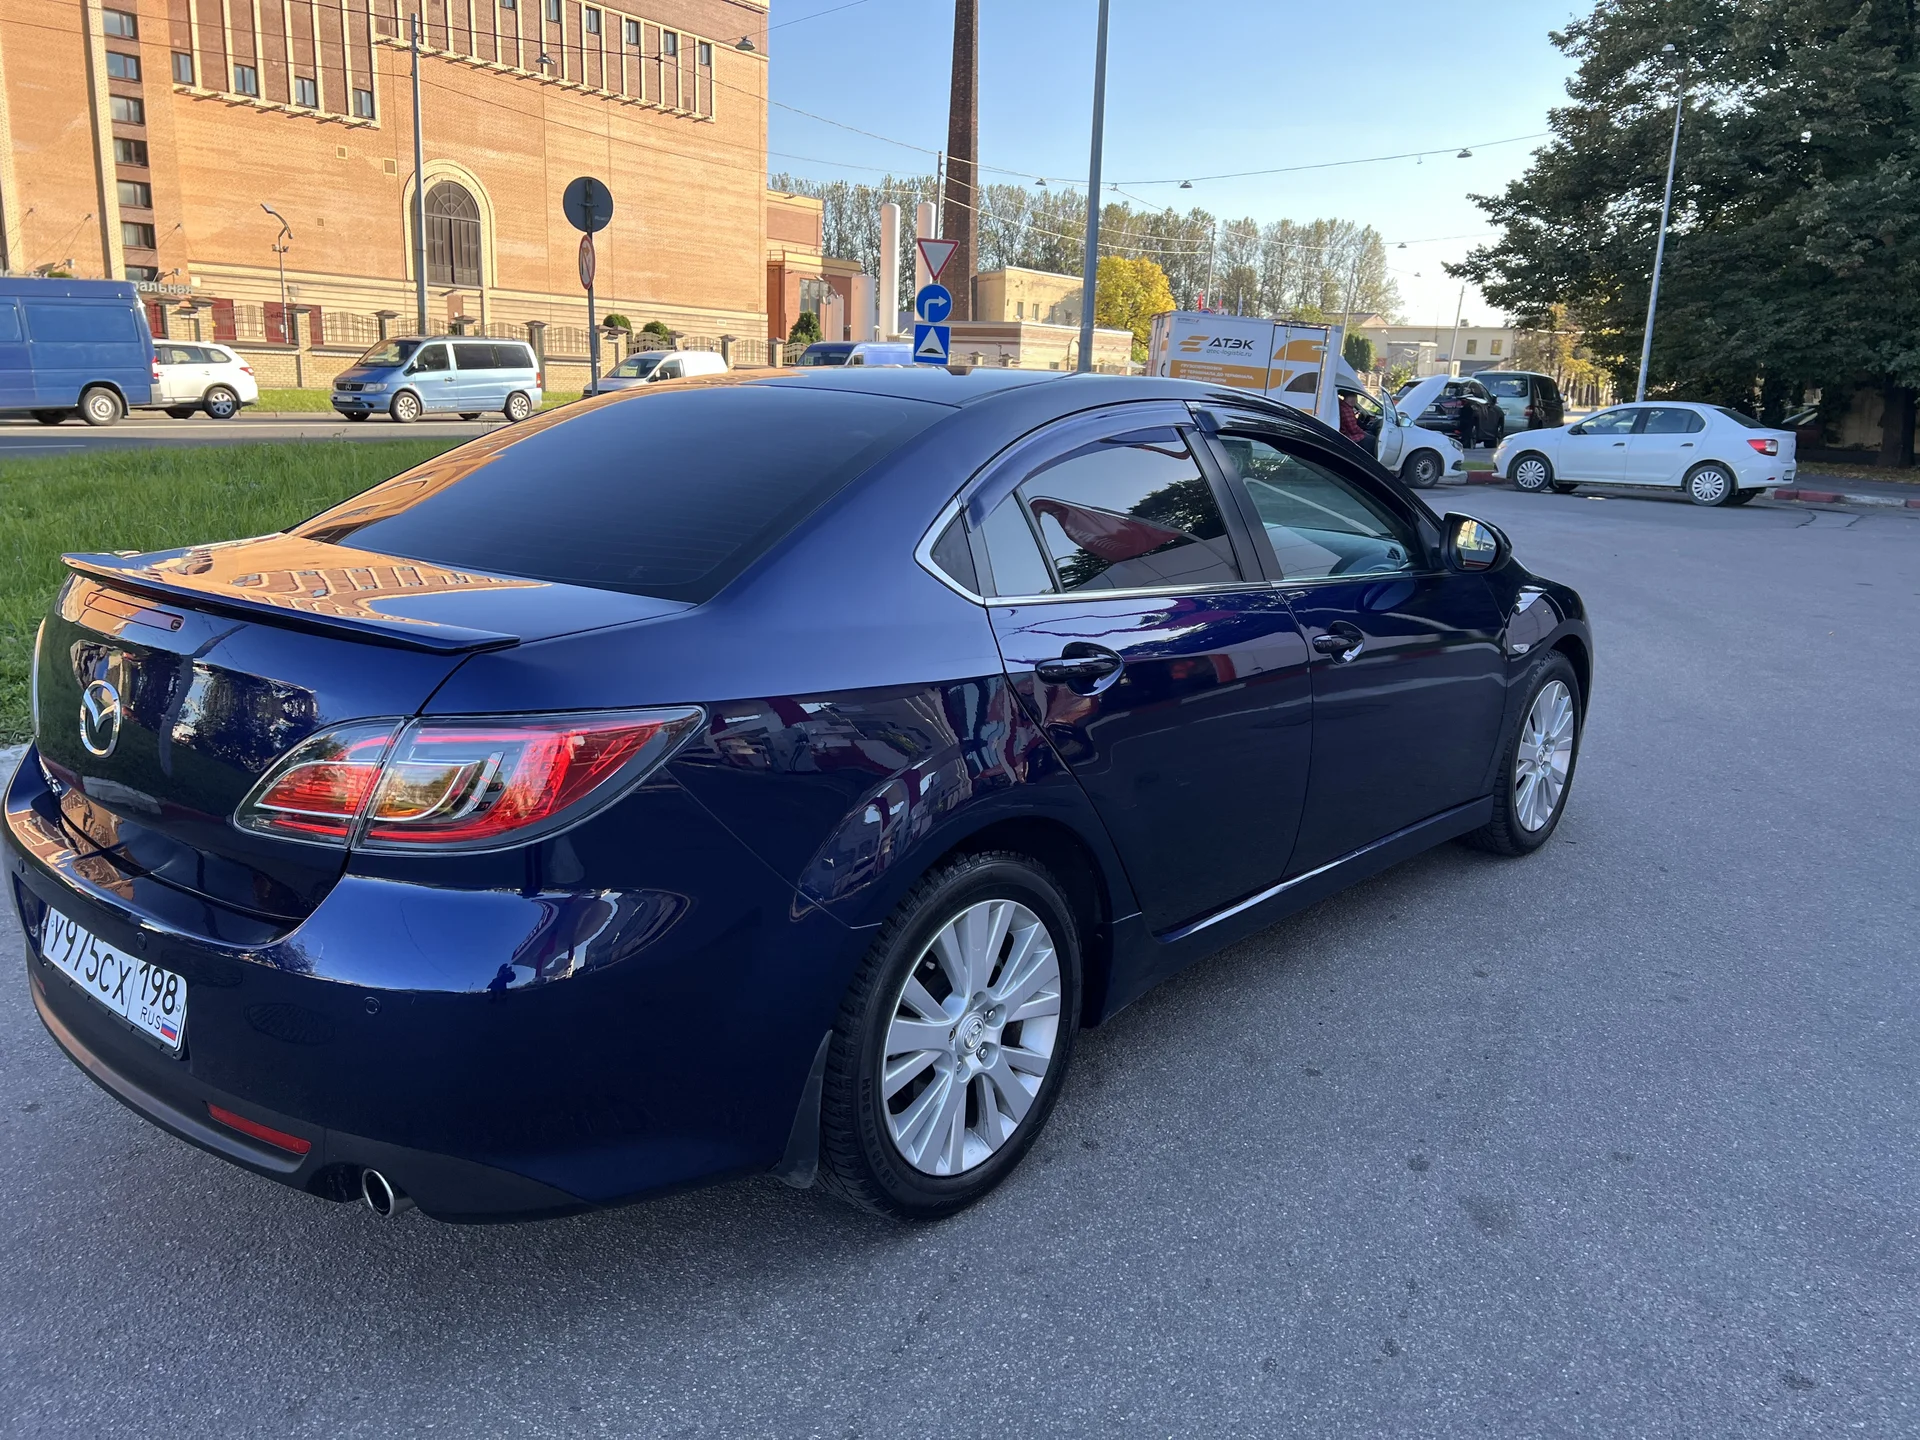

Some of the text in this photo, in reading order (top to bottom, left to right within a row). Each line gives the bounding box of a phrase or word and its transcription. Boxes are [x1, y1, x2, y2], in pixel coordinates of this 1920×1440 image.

[1209, 337, 1255, 350] АТЭК
[1206, 349, 1252, 357] atec-logistic.ru
[139, 963, 178, 1015] 198
[140, 1006, 162, 1030] RUS
